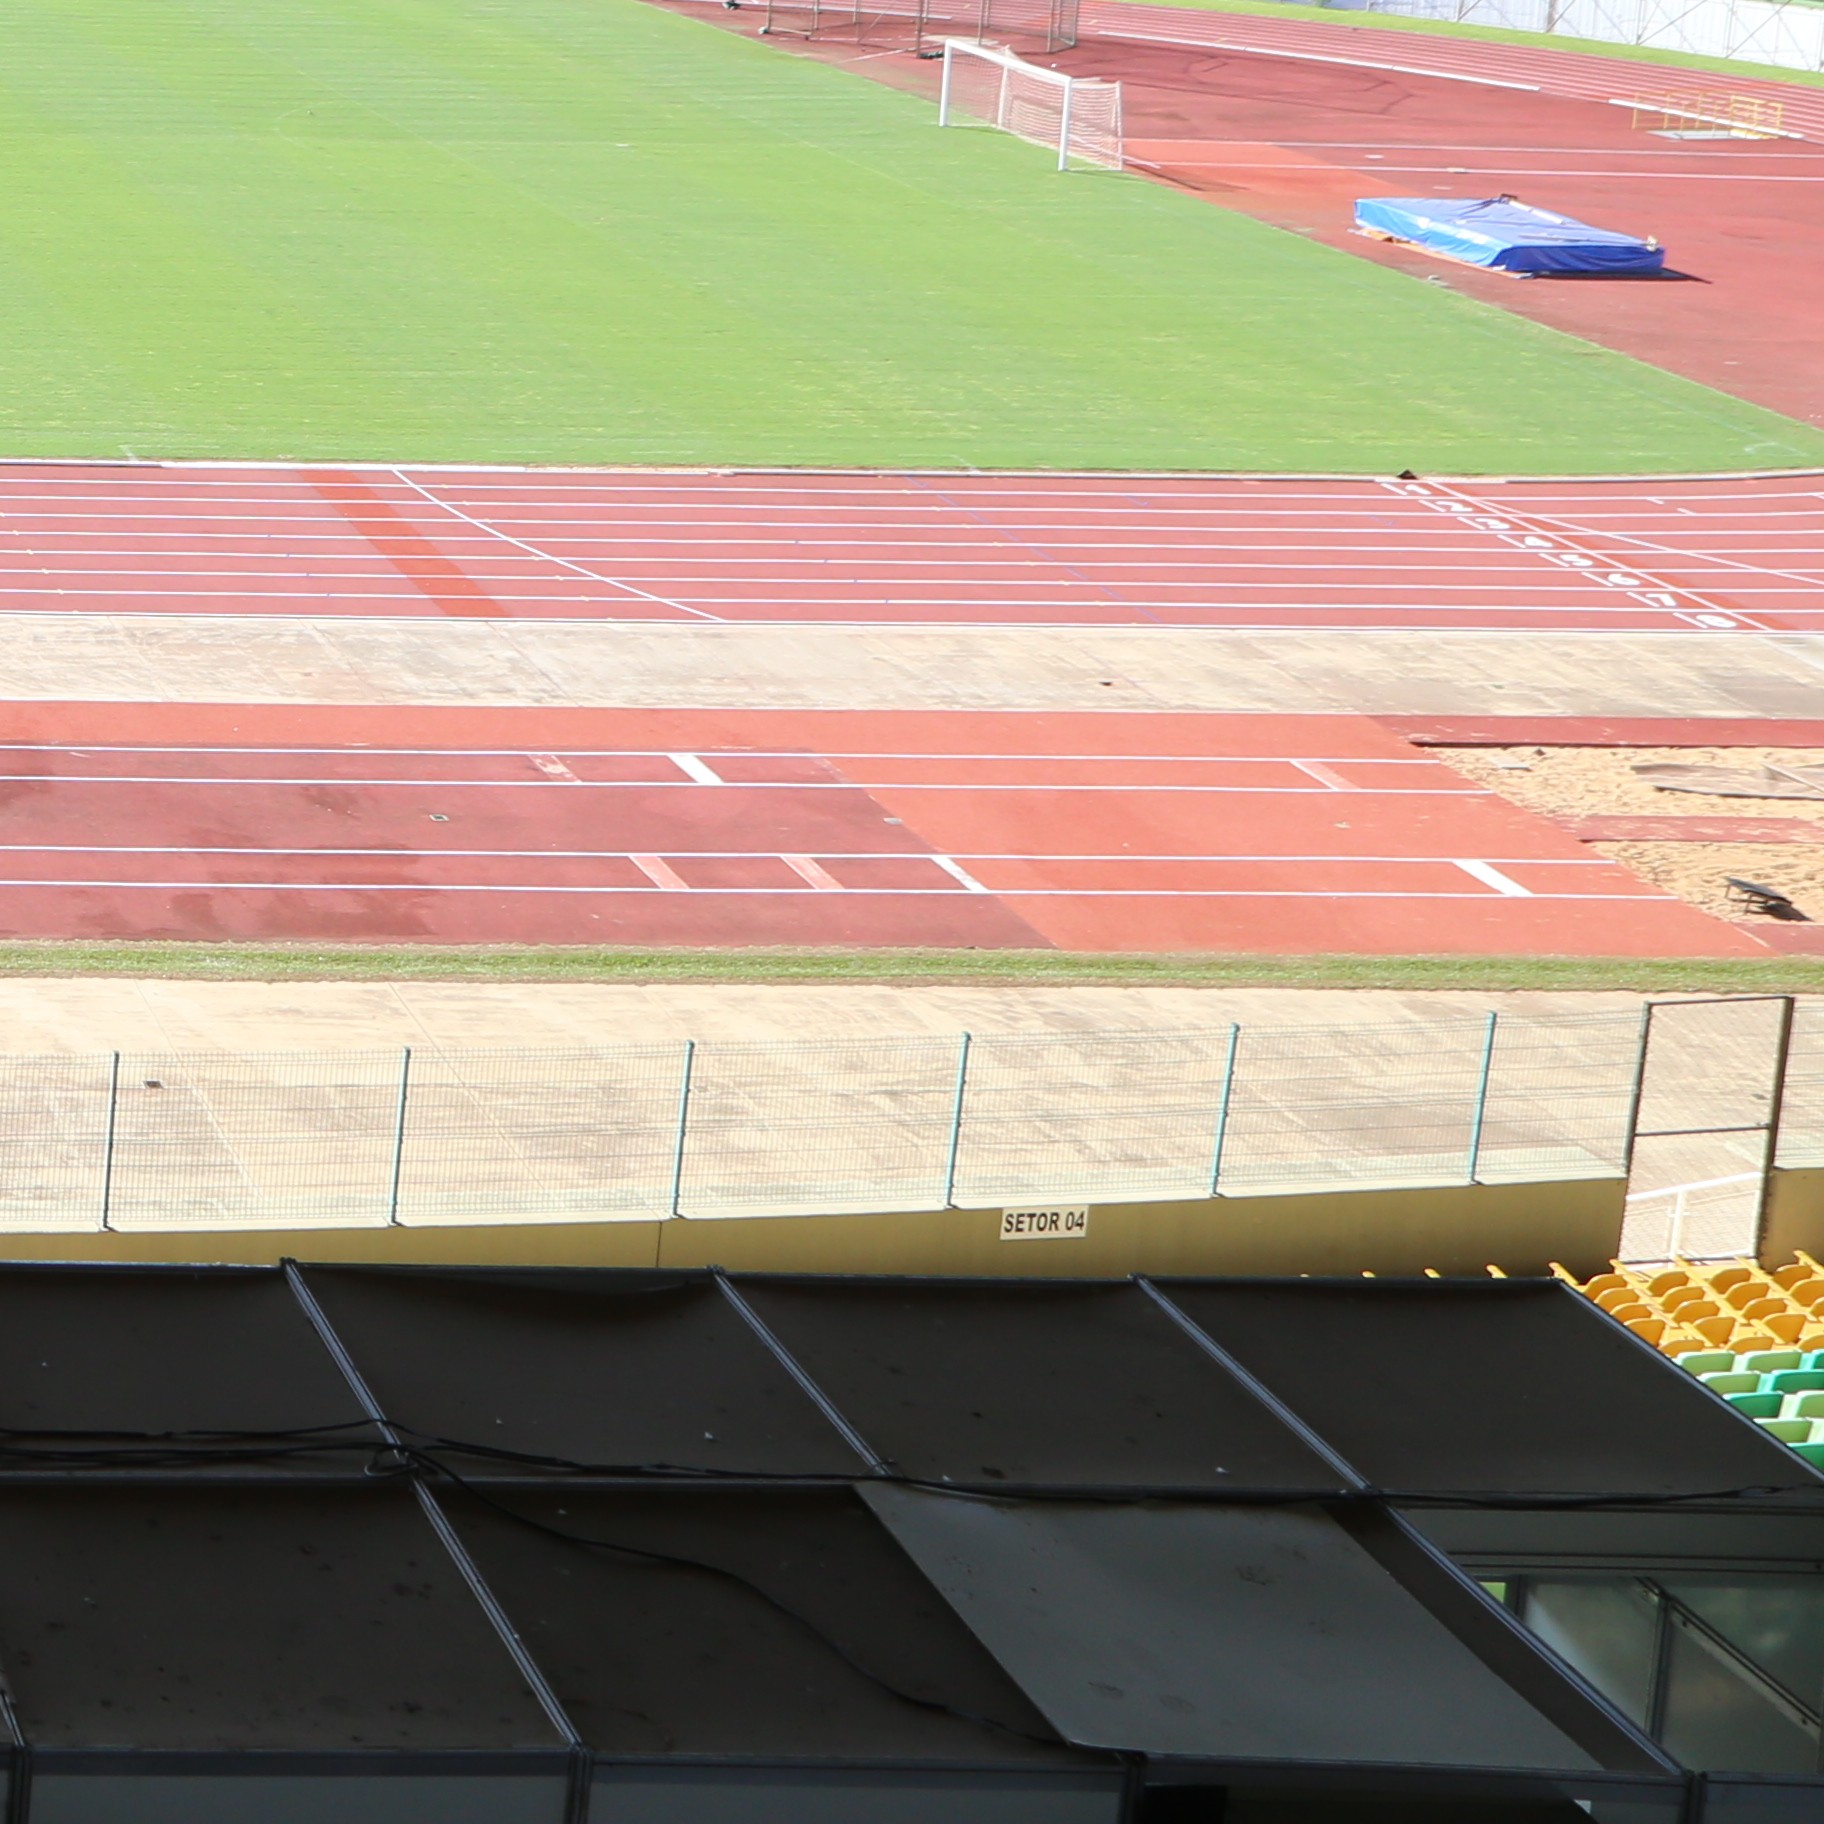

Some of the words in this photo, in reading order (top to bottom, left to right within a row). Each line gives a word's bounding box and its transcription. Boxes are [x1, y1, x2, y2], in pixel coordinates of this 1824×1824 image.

[1404, 483, 1432, 495] 1
[1435, 500, 1473, 513] 2
[1475, 517, 1512, 530] 3
[1524, 535, 1554, 548] 4
[1559, 553, 1594, 567] 5
[1607, 573, 1641, 586] 6
[1645, 592, 1677, 607] 7
[1696, 613, 1738, 628] 8
[1003, 1212, 1060, 1233] SETOR
[1065, 1211, 1086, 1231] 04
